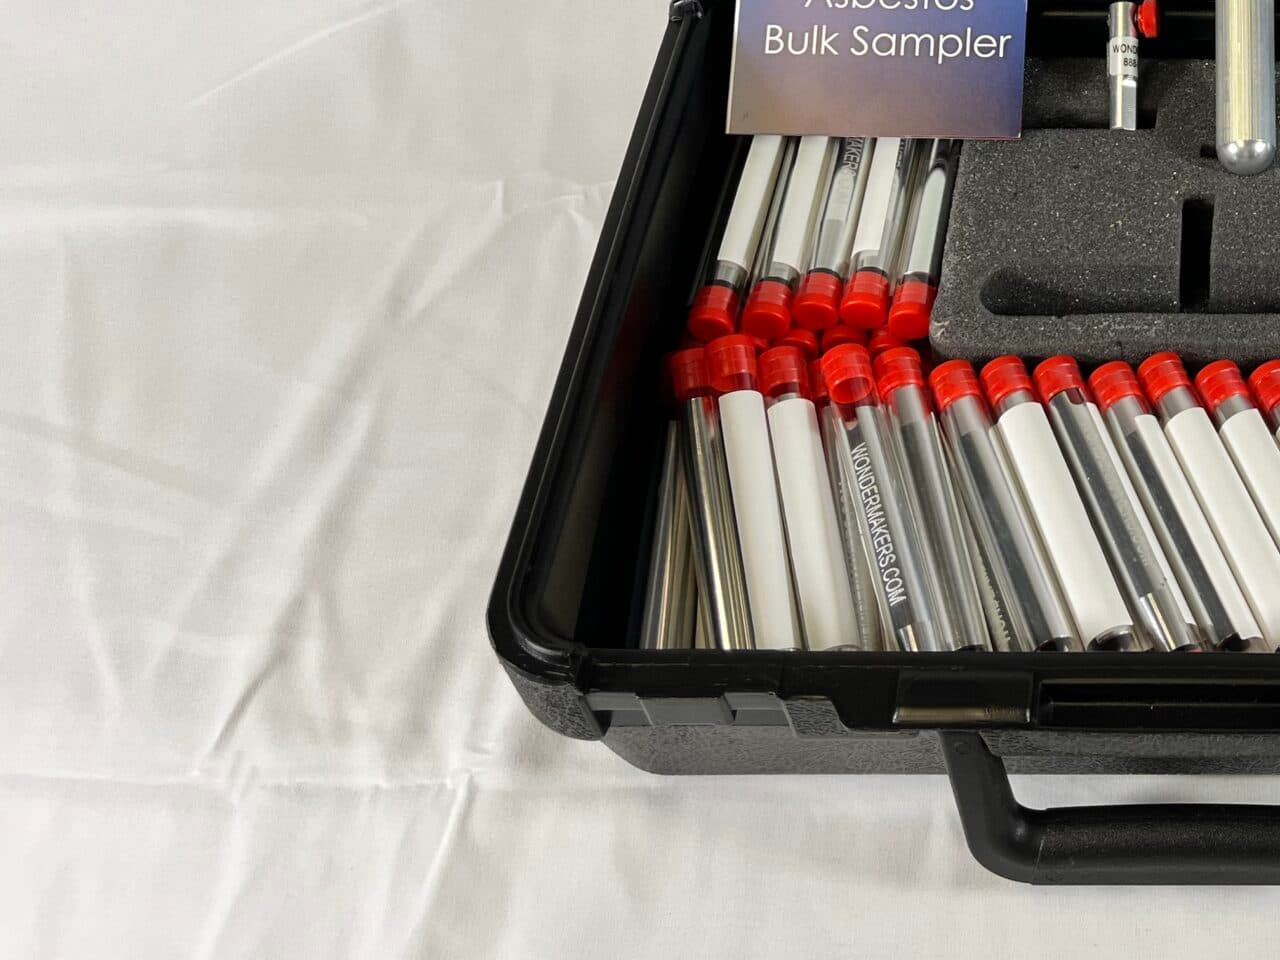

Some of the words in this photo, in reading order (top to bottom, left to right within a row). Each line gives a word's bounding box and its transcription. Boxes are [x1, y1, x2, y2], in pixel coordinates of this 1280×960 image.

[764, 24, 839, 56] Bulk
[850, 26, 1012, 64] Sampler
[851, 442, 907, 607] WONDERMAKERS.COM
